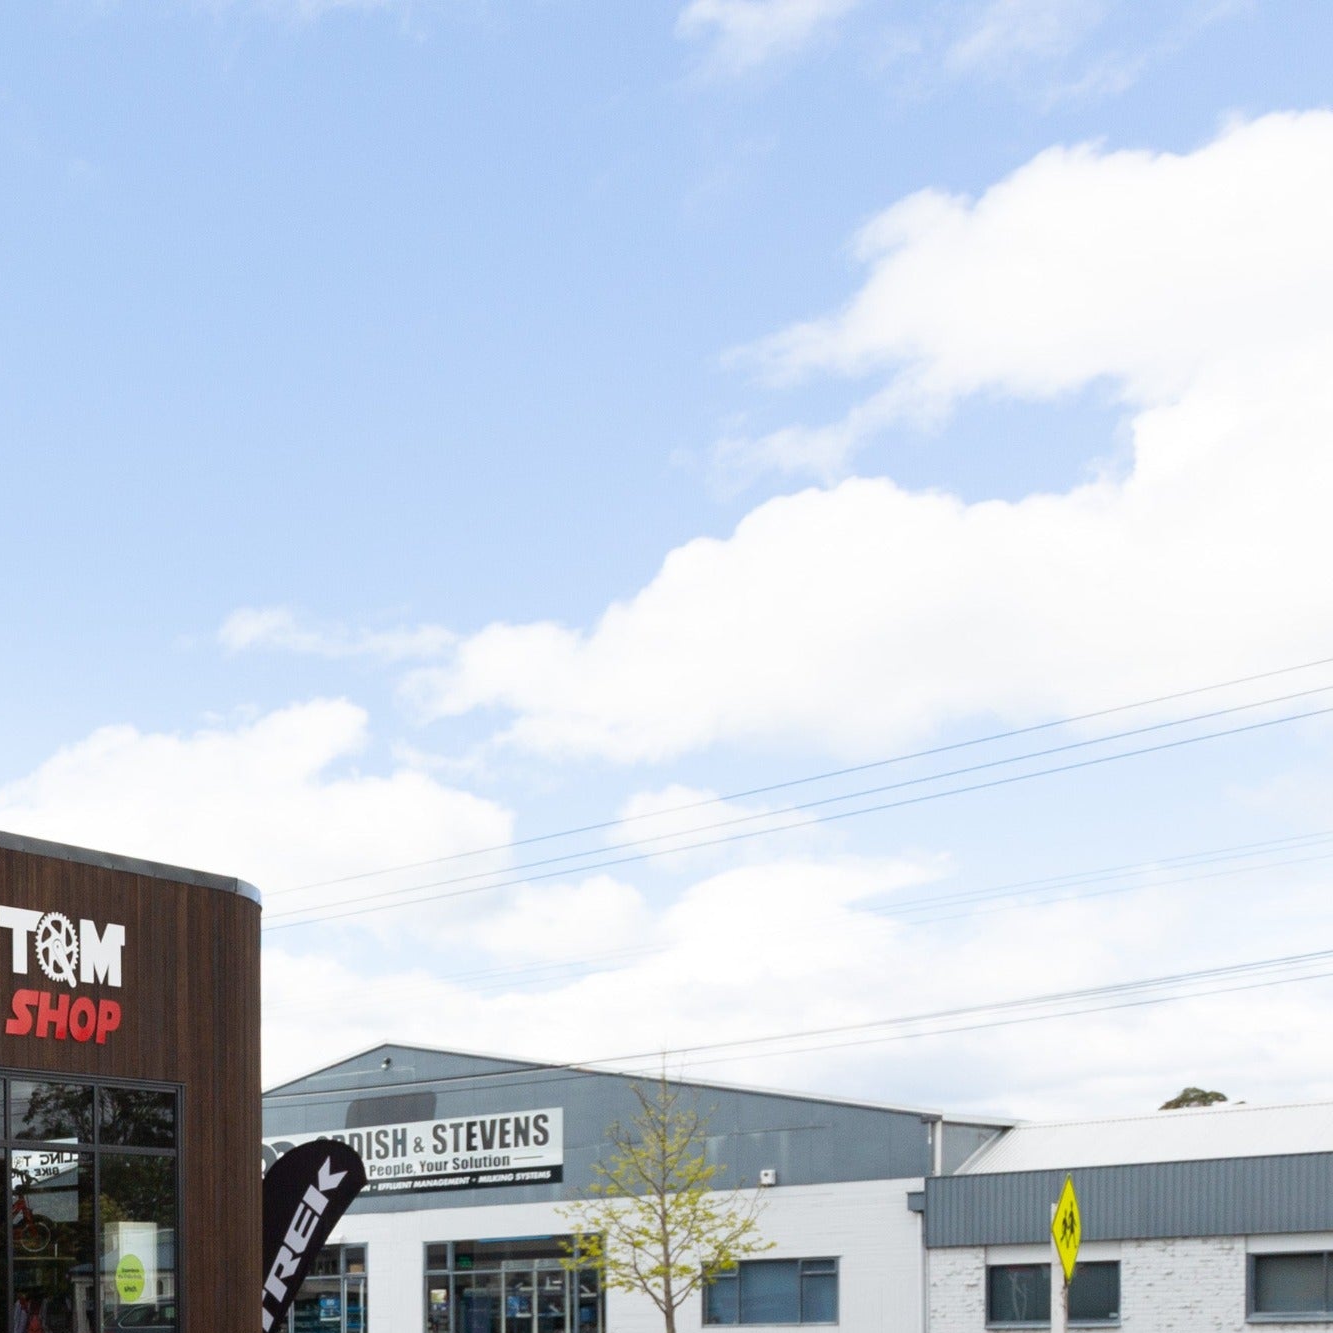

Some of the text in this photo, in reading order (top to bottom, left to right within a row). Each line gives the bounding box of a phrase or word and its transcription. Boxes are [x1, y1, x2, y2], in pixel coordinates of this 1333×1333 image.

[6, 988, 122, 1045] SHOP
[413, 1136, 425, 1153] &
[432, 1113, 550, 1155] STEVENS
[369, 1154, 511, 1177] People, Your Solution
[515, 1170, 552, 1181] SYSTEMS
